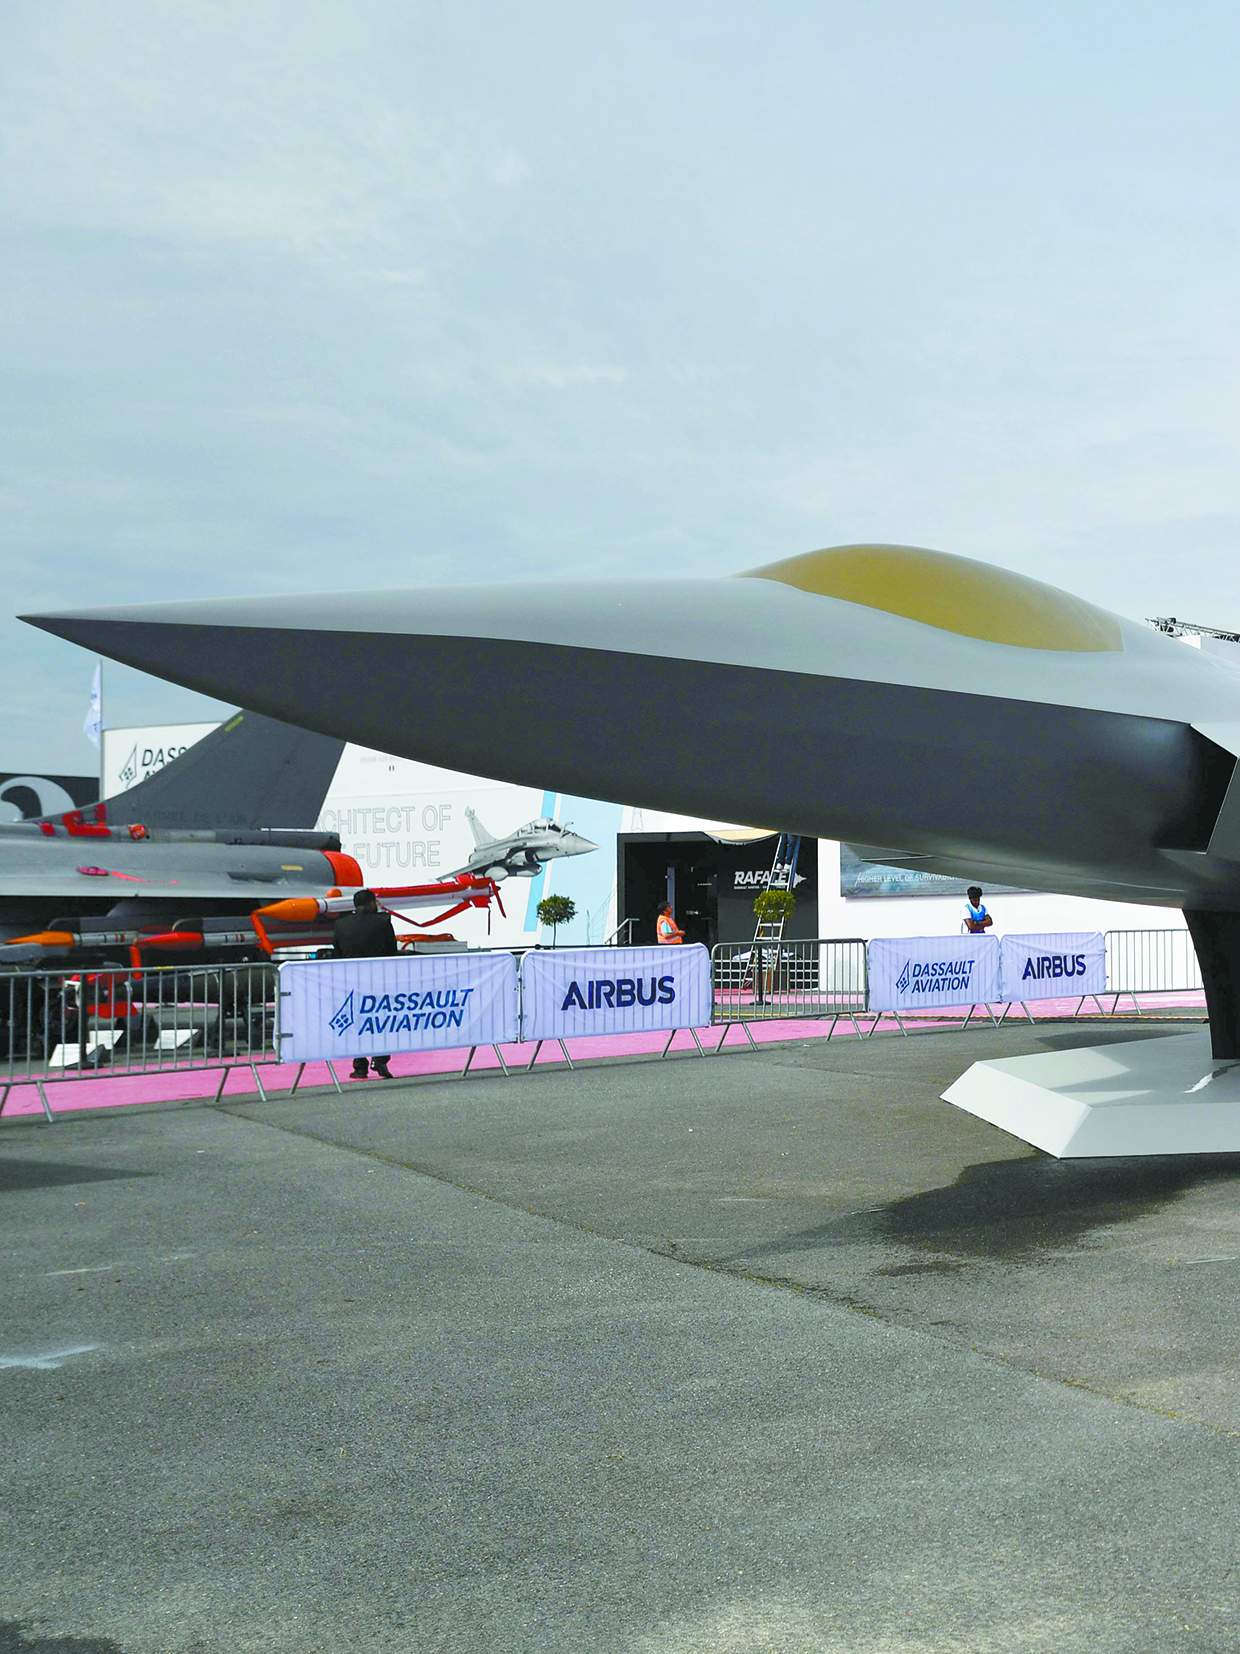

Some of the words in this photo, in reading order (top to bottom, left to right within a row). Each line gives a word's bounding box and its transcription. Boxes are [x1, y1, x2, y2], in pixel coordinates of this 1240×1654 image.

[317, 804, 416, 834] CHITECT
[421, 804, 452, 832] OF
[733, 870, 787, 885] RAFAE
[883, 874, 903, 882] LEVEL
[904, 874, 915, 882] OF
[912, 959, 976, 978] DASSAULT
[1021, 954, 1087, 980] AIRBUS
[560, 975, 676, 1011] AIRBUS
[911, 975, 970, 994] AVIATION
[359, 988, 475, 1015] DASSAULT
[358, 1009, 464, 1036] AVIATION
